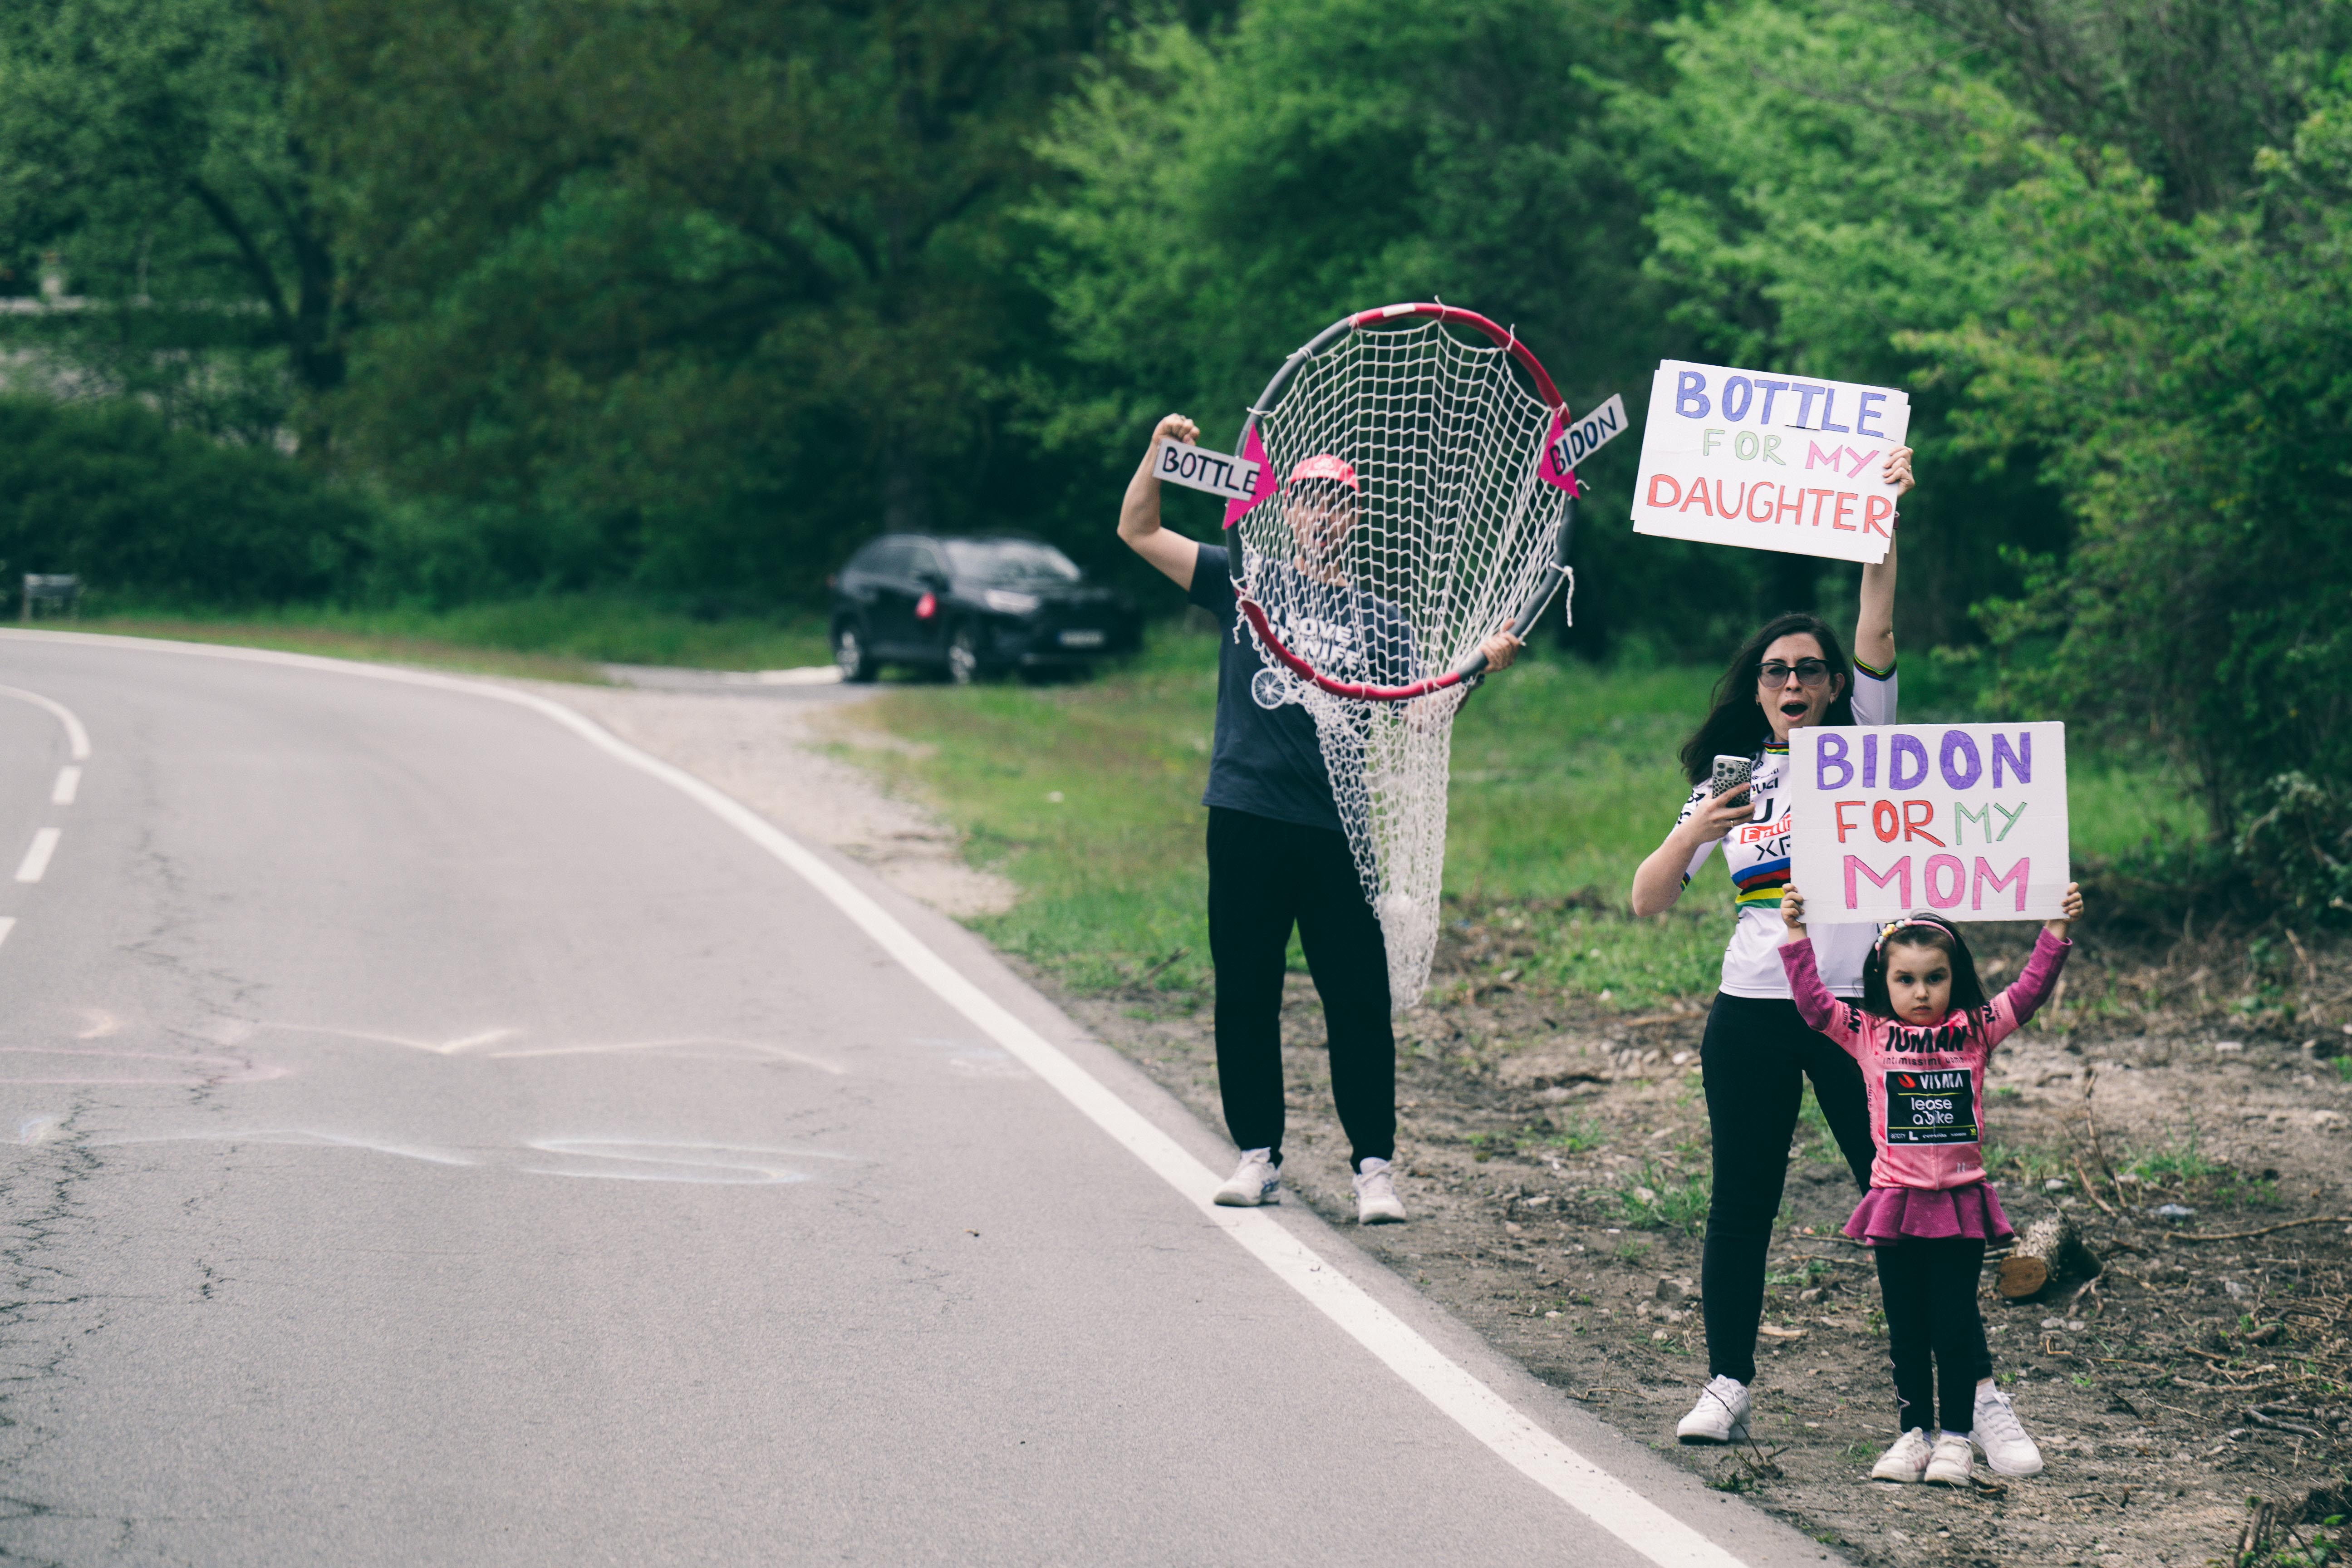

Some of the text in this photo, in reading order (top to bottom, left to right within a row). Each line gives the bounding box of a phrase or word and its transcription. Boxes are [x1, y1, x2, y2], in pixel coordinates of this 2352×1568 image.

[1676, 371, 1887, 437] BOTTLE
[1549, 406, 1617, 476] BIDON
[1703, 429, 1880, 478] FOR MY
[1163, 446, 1260, 495] BOTTLE
[1647, 474, 1892, 539] DAUGHTER
[1817, 730, 2031, 791] BIDON
[1756, 777, 1778, 794] UCI
[1835, 800, 1946, 847] FOR
[1955, 802, 2027, 845] MY
[1844, 854, 2030, 911] MOM
[1883, 1057, 1941, 1066] intimissimi
[1885, 1026, 1967, 1053] IUMAN
[1911, 1097, 1953, 1111] lease
[1920, 1072, 1964, 1089] VISMA
